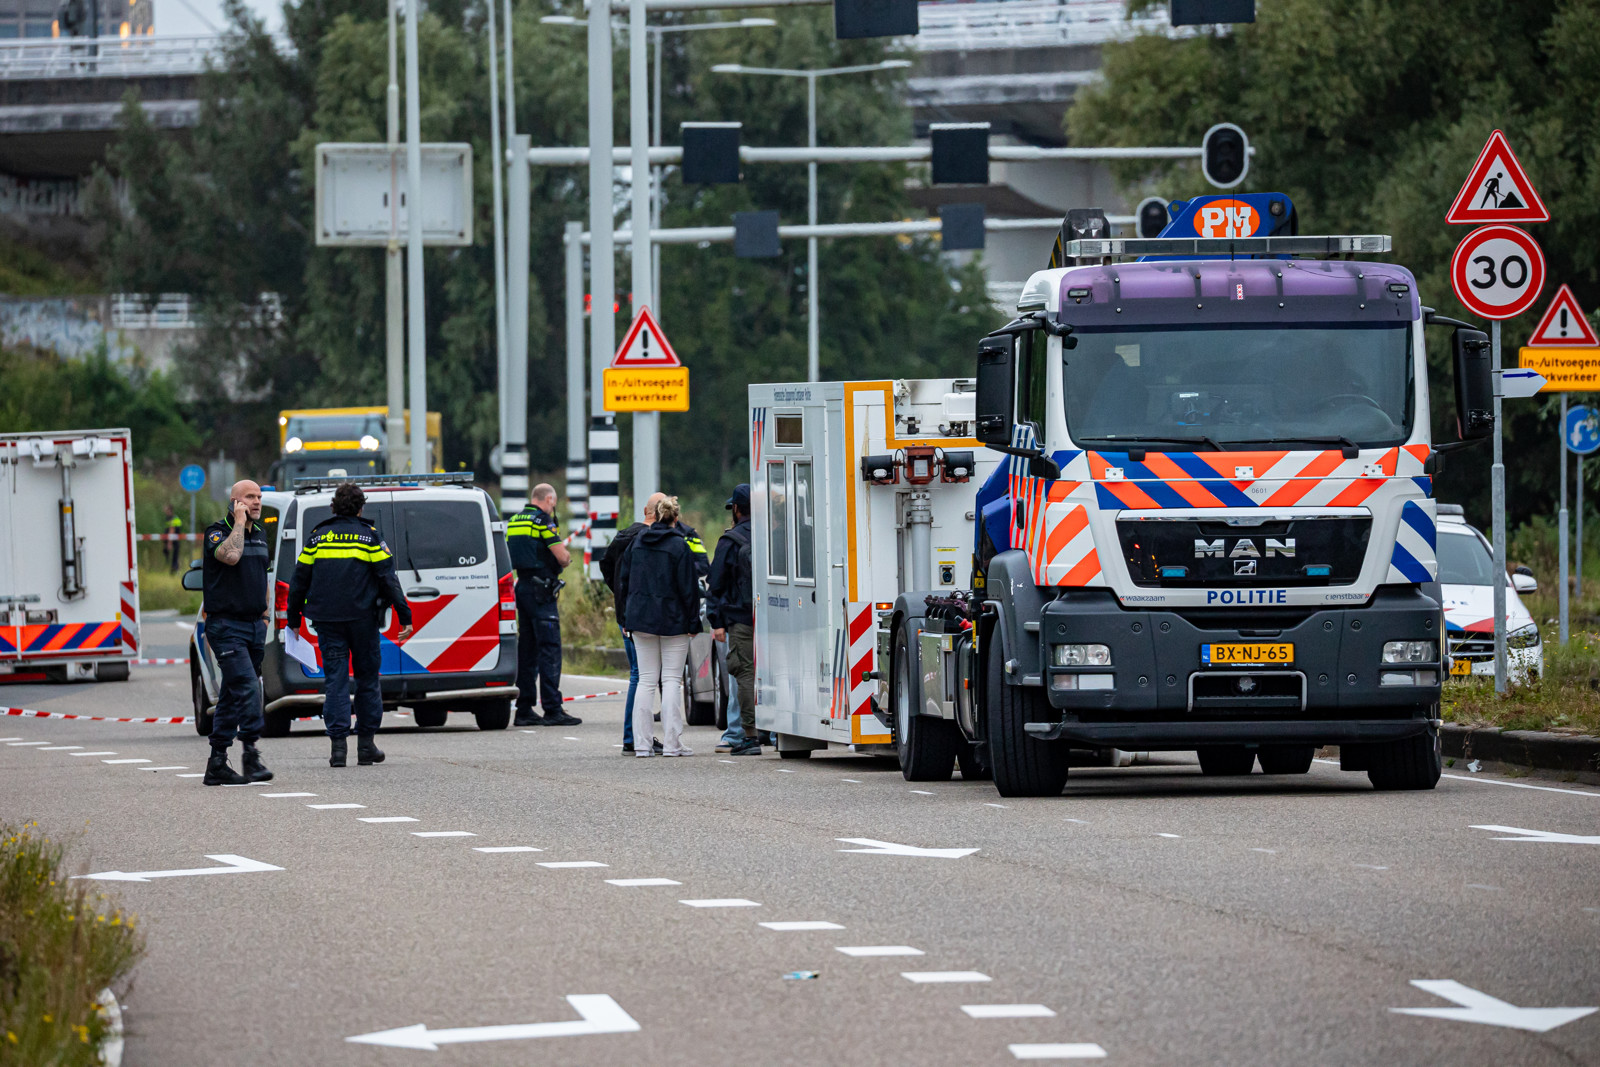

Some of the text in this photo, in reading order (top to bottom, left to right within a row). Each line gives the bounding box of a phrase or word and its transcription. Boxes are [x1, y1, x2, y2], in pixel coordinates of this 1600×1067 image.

[1201, 207, 1252, 238] PM
[1470, 255, 1528, 289] 30
[1541, 372, 1598, 382] rkverkeer
[614, 393, 678, 402] werkverkeer
[1194, 538, 1296, 558] MAN
[458, 556, 477, 565] OvD
[1207, 589, 1287, 605] POLITIE
[1216, 646, 1288, 660] BX-NJ-65
